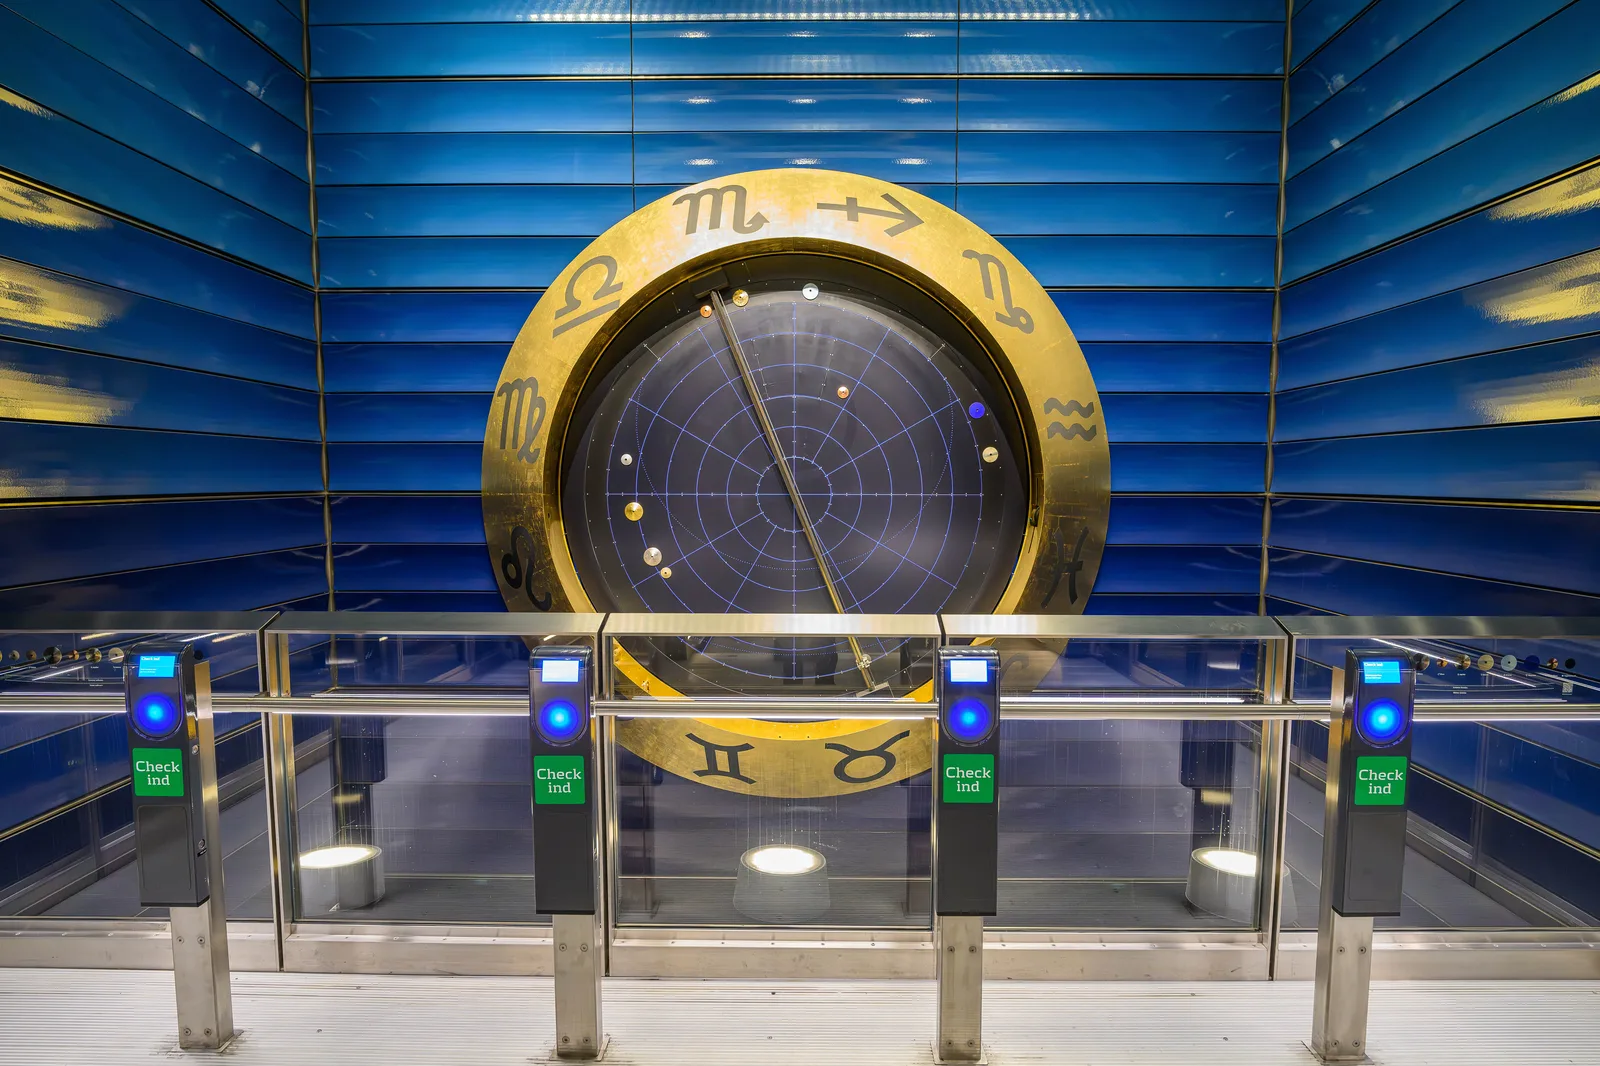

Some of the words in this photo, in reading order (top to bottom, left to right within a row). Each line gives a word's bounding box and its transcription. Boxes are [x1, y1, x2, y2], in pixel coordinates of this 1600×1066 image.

[136, 760, 180, 773] Check
[945, 766, 991, 779] Check
[147, 774, 171, 786] ind
[536, 768, 582, 780] Check
[1358, 769, 1404, 781] Check
[548, 781, 572, 793] ind
[956, 780, 980, 792] ind
[1368, 782, 1392, 794] ind
